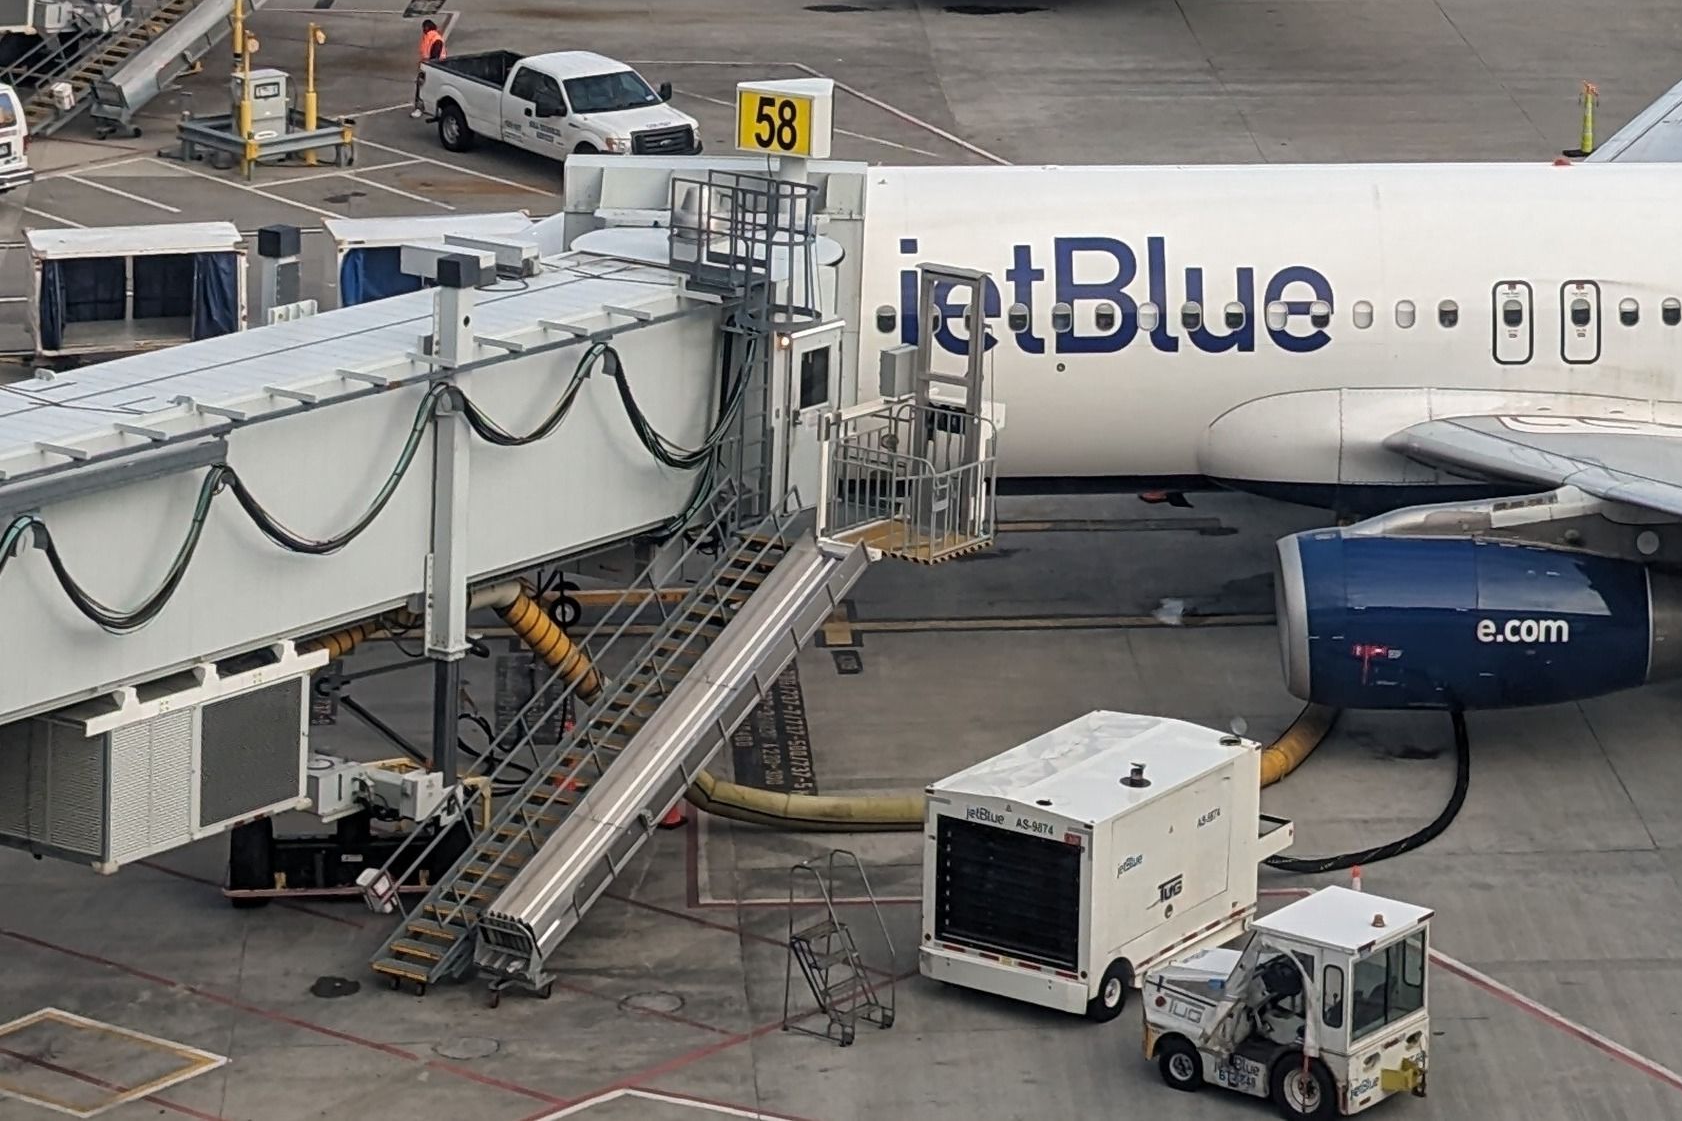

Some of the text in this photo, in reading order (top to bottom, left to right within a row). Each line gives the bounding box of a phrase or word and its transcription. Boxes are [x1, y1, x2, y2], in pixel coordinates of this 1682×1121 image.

[754, 97, 797, 151] 58
[899, 236, 1335, 355] jetBlue
[1476, 618, 1569, 643] e.com
[966, 807, 1005, 824] jetBlue
[1016, 817, 1054, 835] AS-9874
[1157, 873, 1183, 903] TUG
[1169, 993, 1206, 1024] TUG
